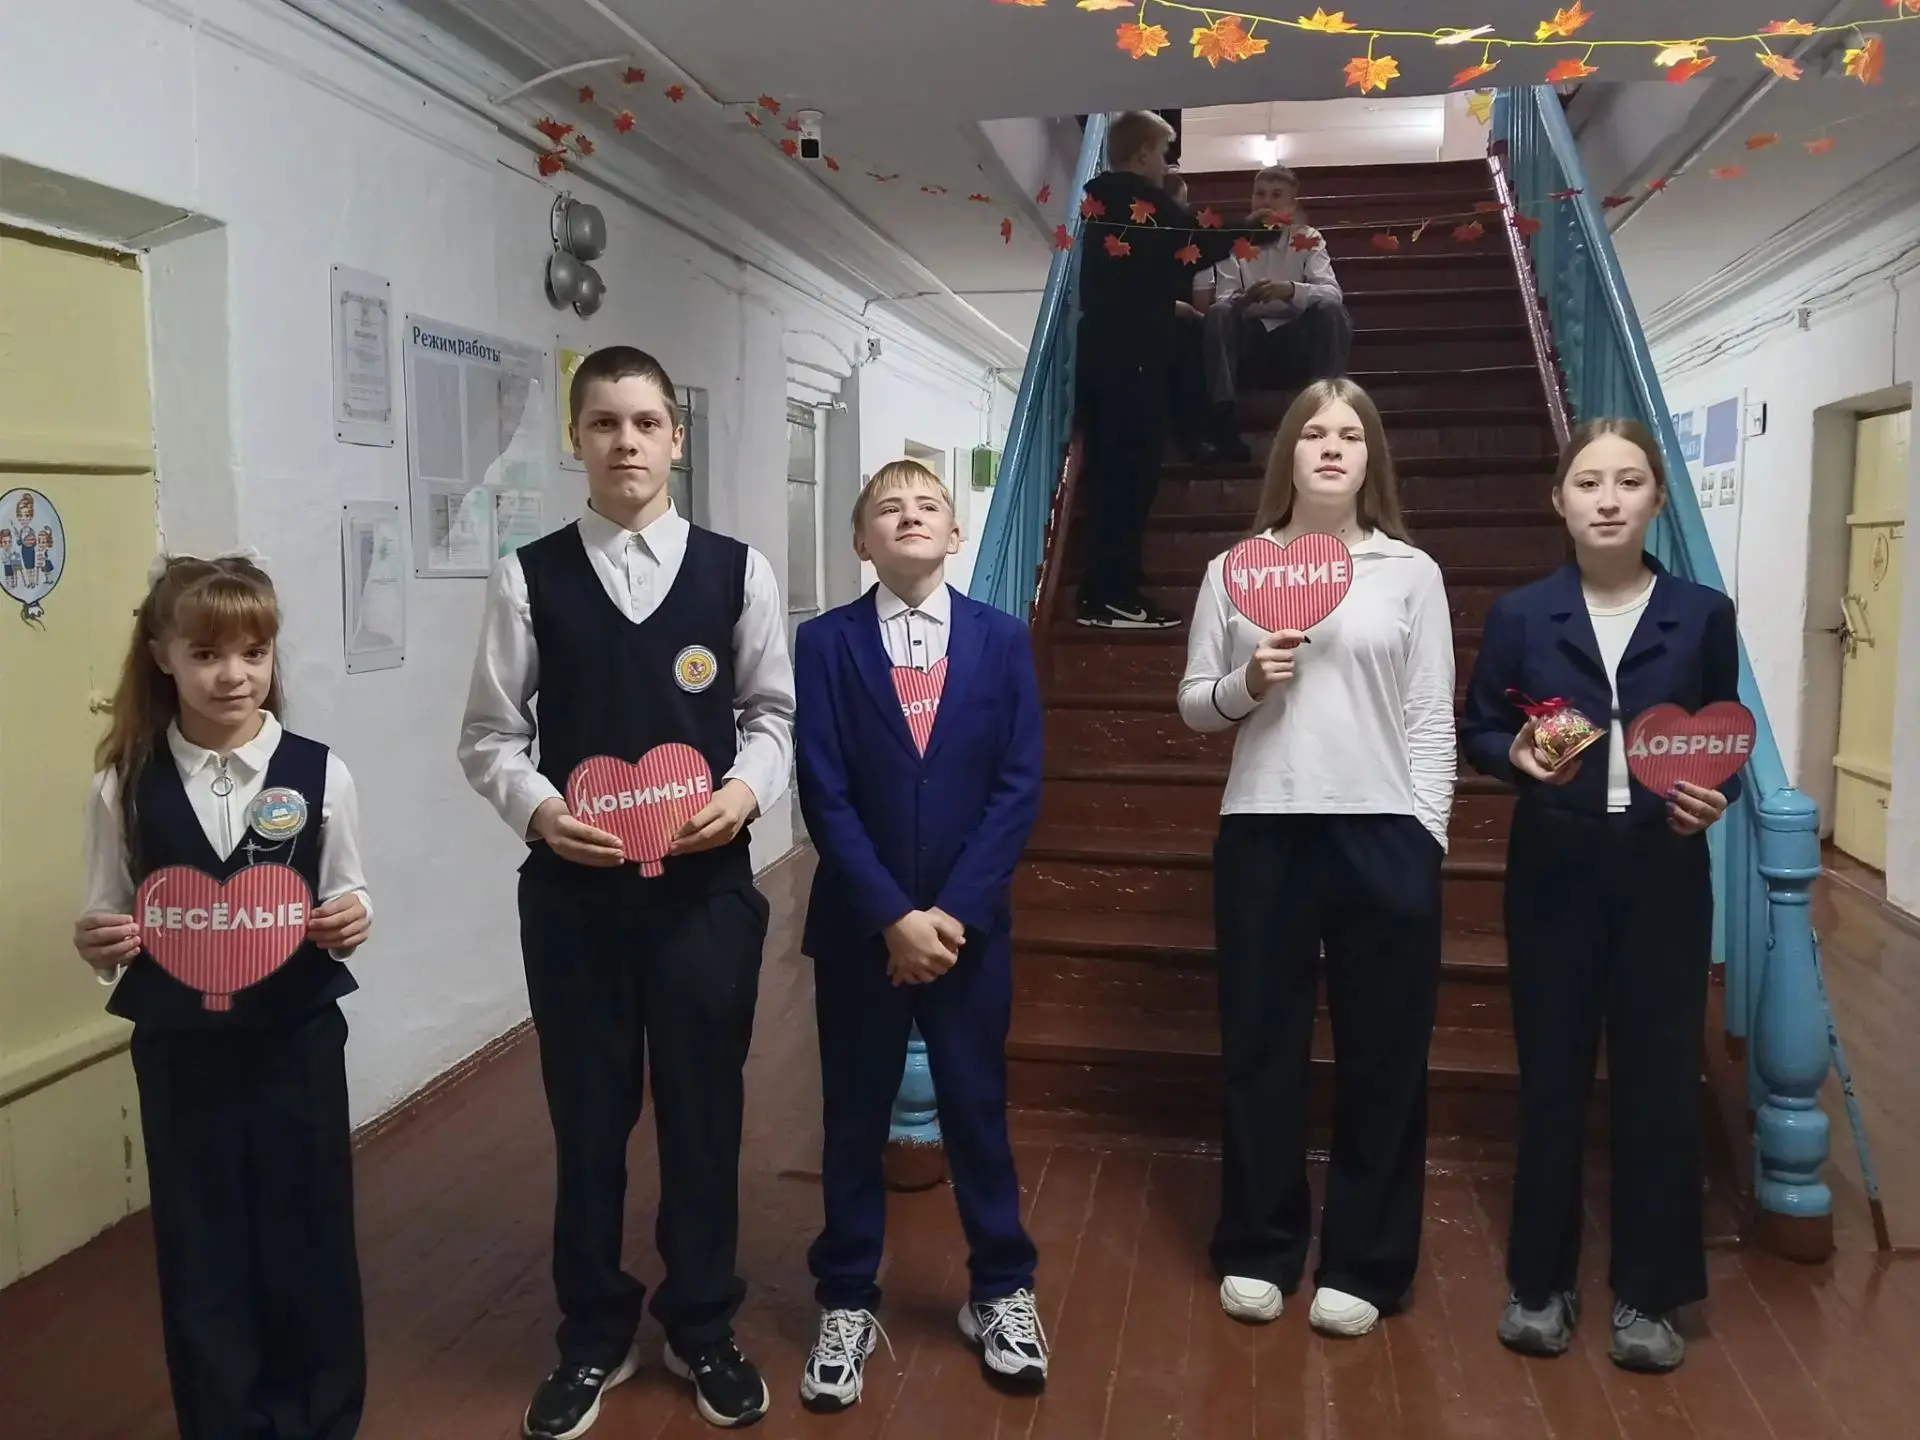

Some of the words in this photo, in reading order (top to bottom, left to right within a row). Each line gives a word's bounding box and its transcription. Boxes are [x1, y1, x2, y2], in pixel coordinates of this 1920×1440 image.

[1231, 560, 1347, 590] ЧУТКИЕ
[1628, 734, 1751, 759] ДОБРЫЕ
[576, 775, 708, 817] ЛЮБИМЫЕ
[144, 902, 304, 931] ВЕСЁЛЫЕ
